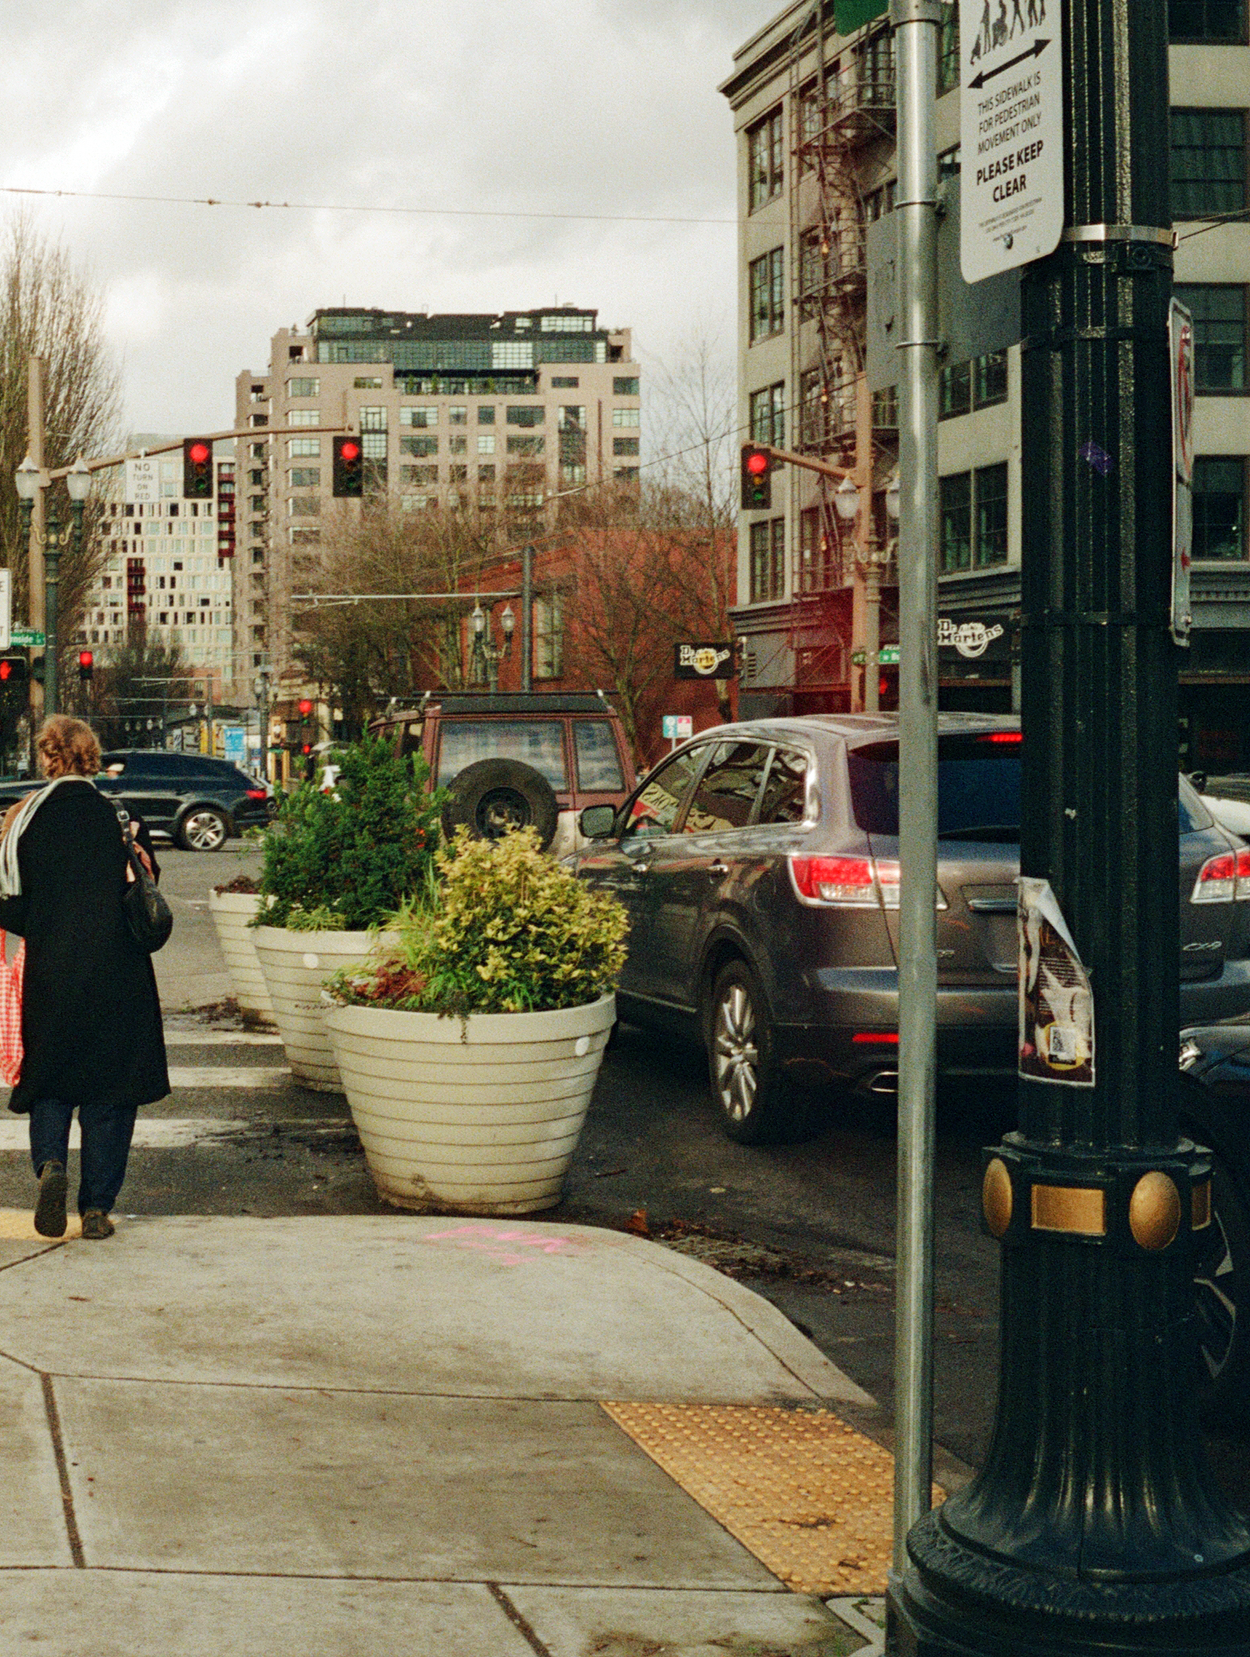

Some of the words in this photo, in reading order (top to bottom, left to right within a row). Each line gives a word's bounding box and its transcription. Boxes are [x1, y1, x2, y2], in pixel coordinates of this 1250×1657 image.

[978, 97, 993, 115] THIS
[995, 76, 1032, 107] SIDEWALK
[1034, 71, 1041, 86] IS
[979, 117, 993, 135] FOR
[995, 91, 1040, 126] PEDESTRIAN
[978, 123, 1019, 155] MOVEMENT
[1021, 112, 1042, 133] ONLY
[977, 154, 1014, 186] PLEASE
[1017, 140, 1044, 167] KEEP
[993, 174, 1026, 203] CLEAR
[134, 463, 150, 471] NO
[941, 625, 1004, 644] Martens
